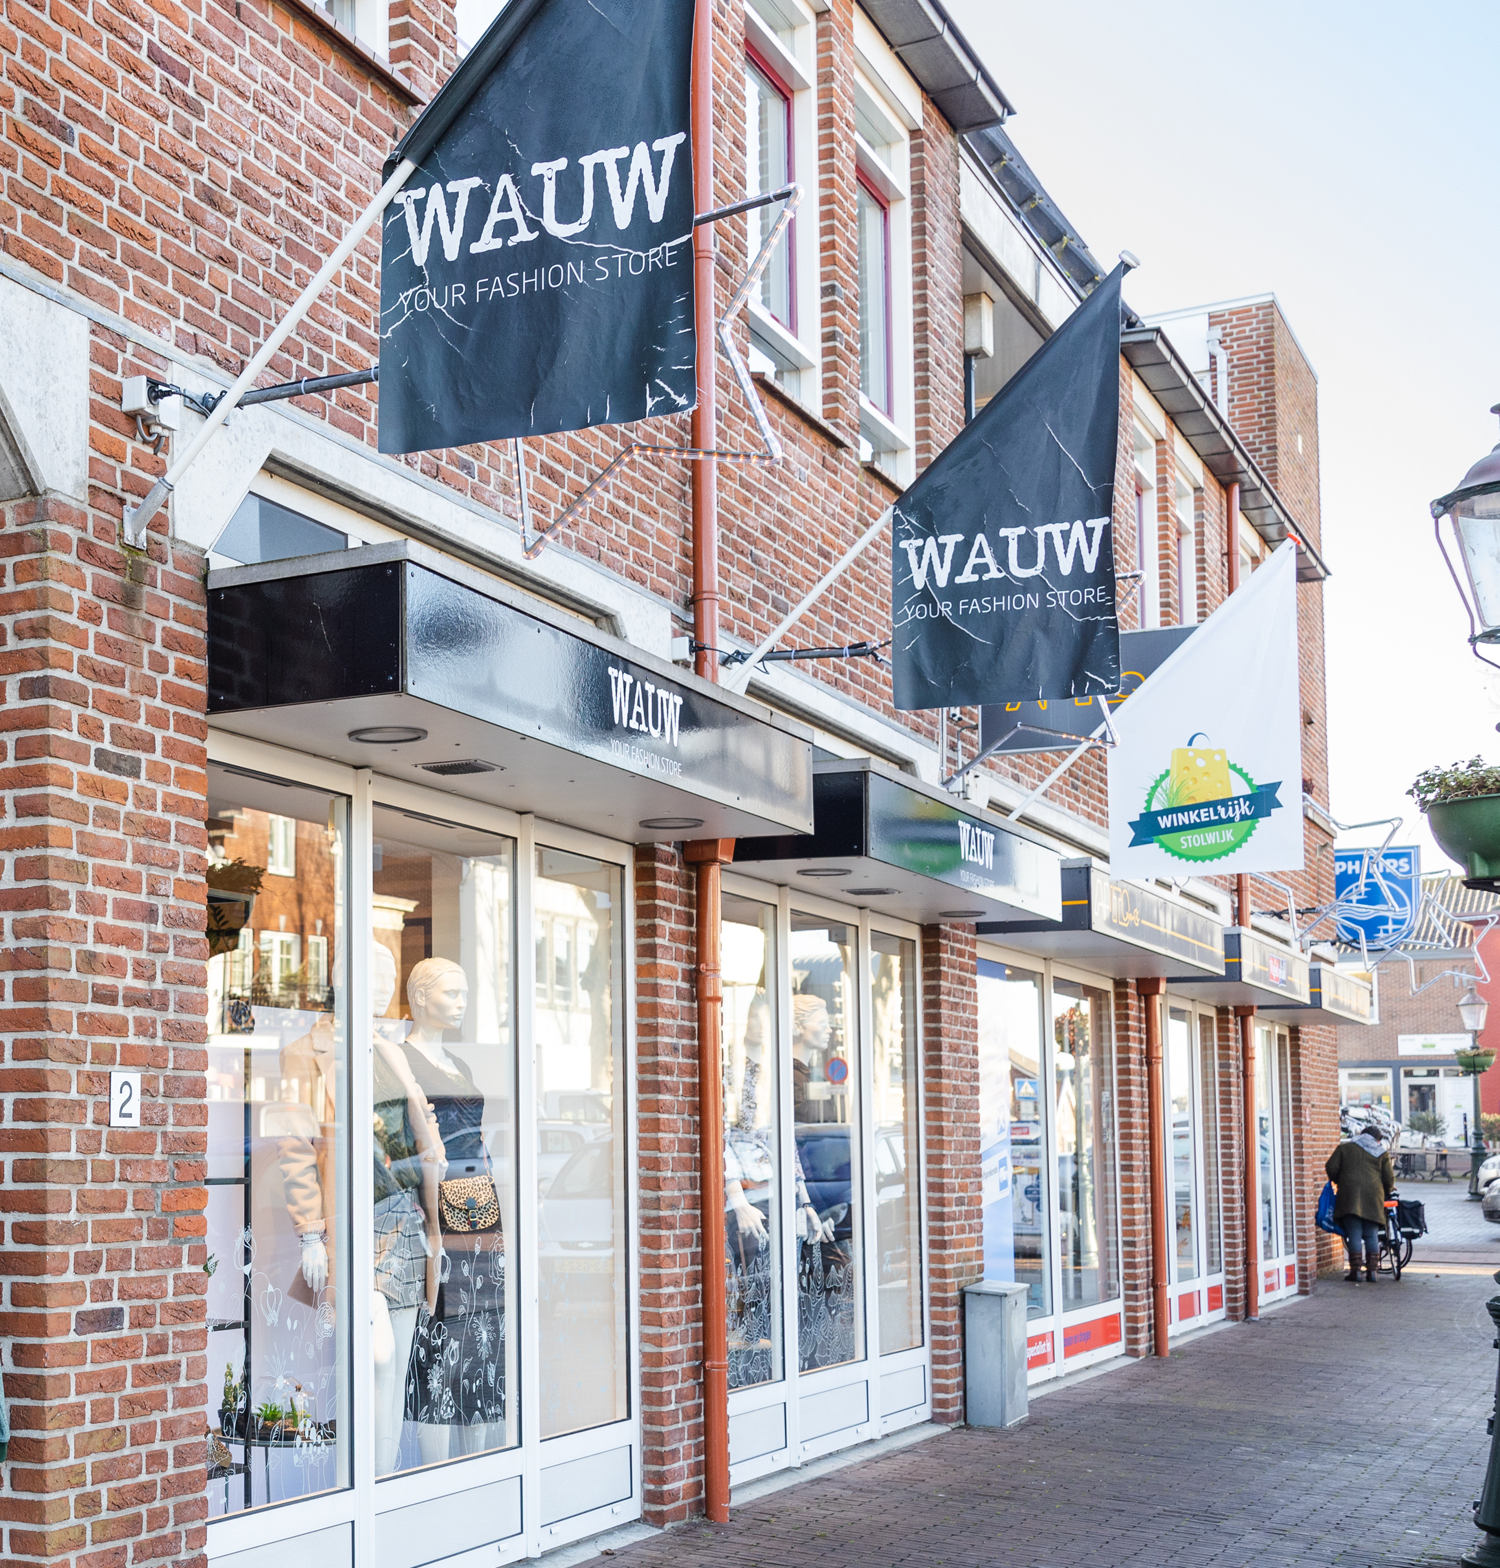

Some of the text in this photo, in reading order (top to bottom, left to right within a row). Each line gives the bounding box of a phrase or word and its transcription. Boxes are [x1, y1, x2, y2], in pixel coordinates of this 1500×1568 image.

[394, 132, 686, 266] WAUW
[399, 246, 678, 313] YOUR FASHION STORE
[899, 516, 1110, 590] WAUW
[906, 586, 1106, 620] YOUR FASHION STORE
[608, 666, 683, 747] WAUW
[610, 738, 629, 758] YOUR
[631, 745, 660, 770] FASHION
[1157, 797, 1254, 829] WINKELrijk
[958, 820, 995, 870] WAUW
[1180, 829, 1234, 849] STOLWIJK
[119, 1081, 132, 1118] 2
